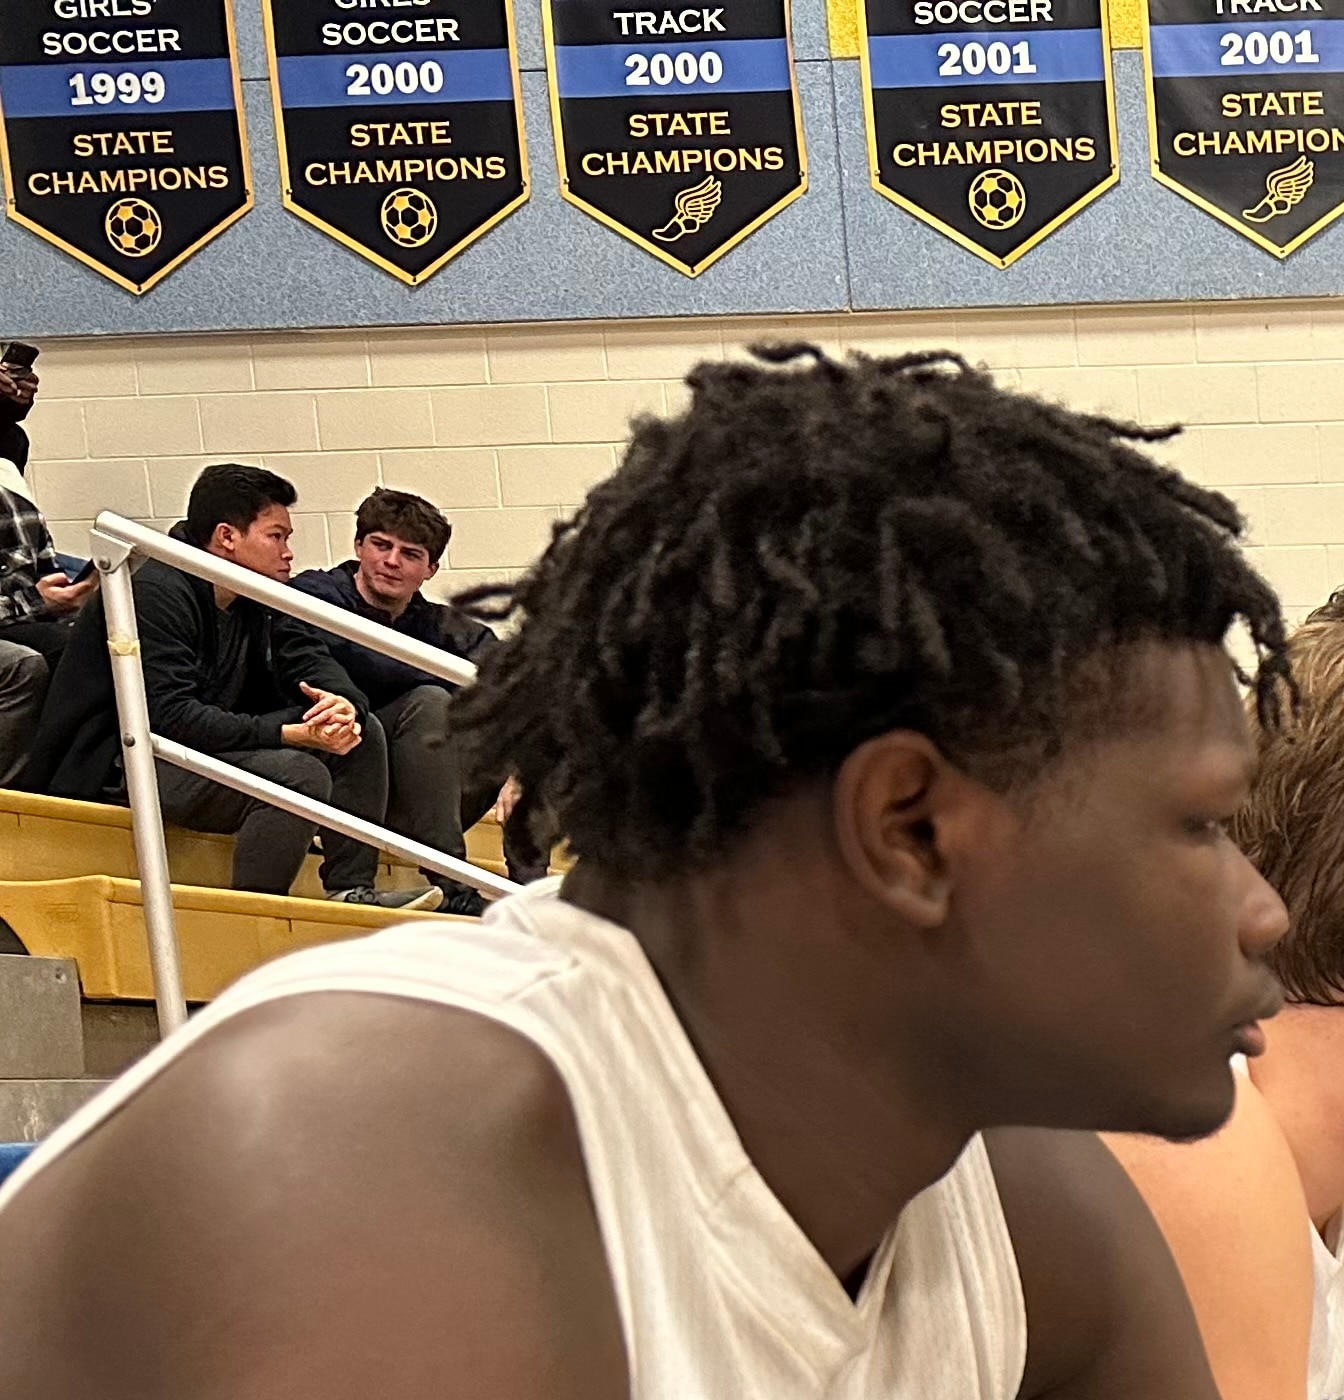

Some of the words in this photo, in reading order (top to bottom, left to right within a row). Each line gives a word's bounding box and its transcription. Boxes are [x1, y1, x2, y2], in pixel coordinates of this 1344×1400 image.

[614, 8, 726, 34] TRACK
[915, 0, 1053, 24] SOCCER
[43, 29, 181, 55] SOCCER
[323, 19, 460, 45] SOCCER
[938, 42, 1036, 75] 2001
[1221, 30, 1319, 65] 2001
[347, 62, 443, 95] 2000
[625, 52, 722, 85] 2000
[70, 72, 164, 105] 1999
[941, 102, 1041, 127] STATE
[1222, 91, 1324, 117] STATE
[351, 121, 451, 146] STATE
[630, 112, 730, 137] STATE
[74, 131, 173, 156] STATE
[894, 138, 1095, 166] CHAMPIONS
[305, 157, 505, 185] CHAMPIONS
[582, 147, 783, 175] CHAMPIONS
[29, 166, 228, 195] CHAMPIONS
